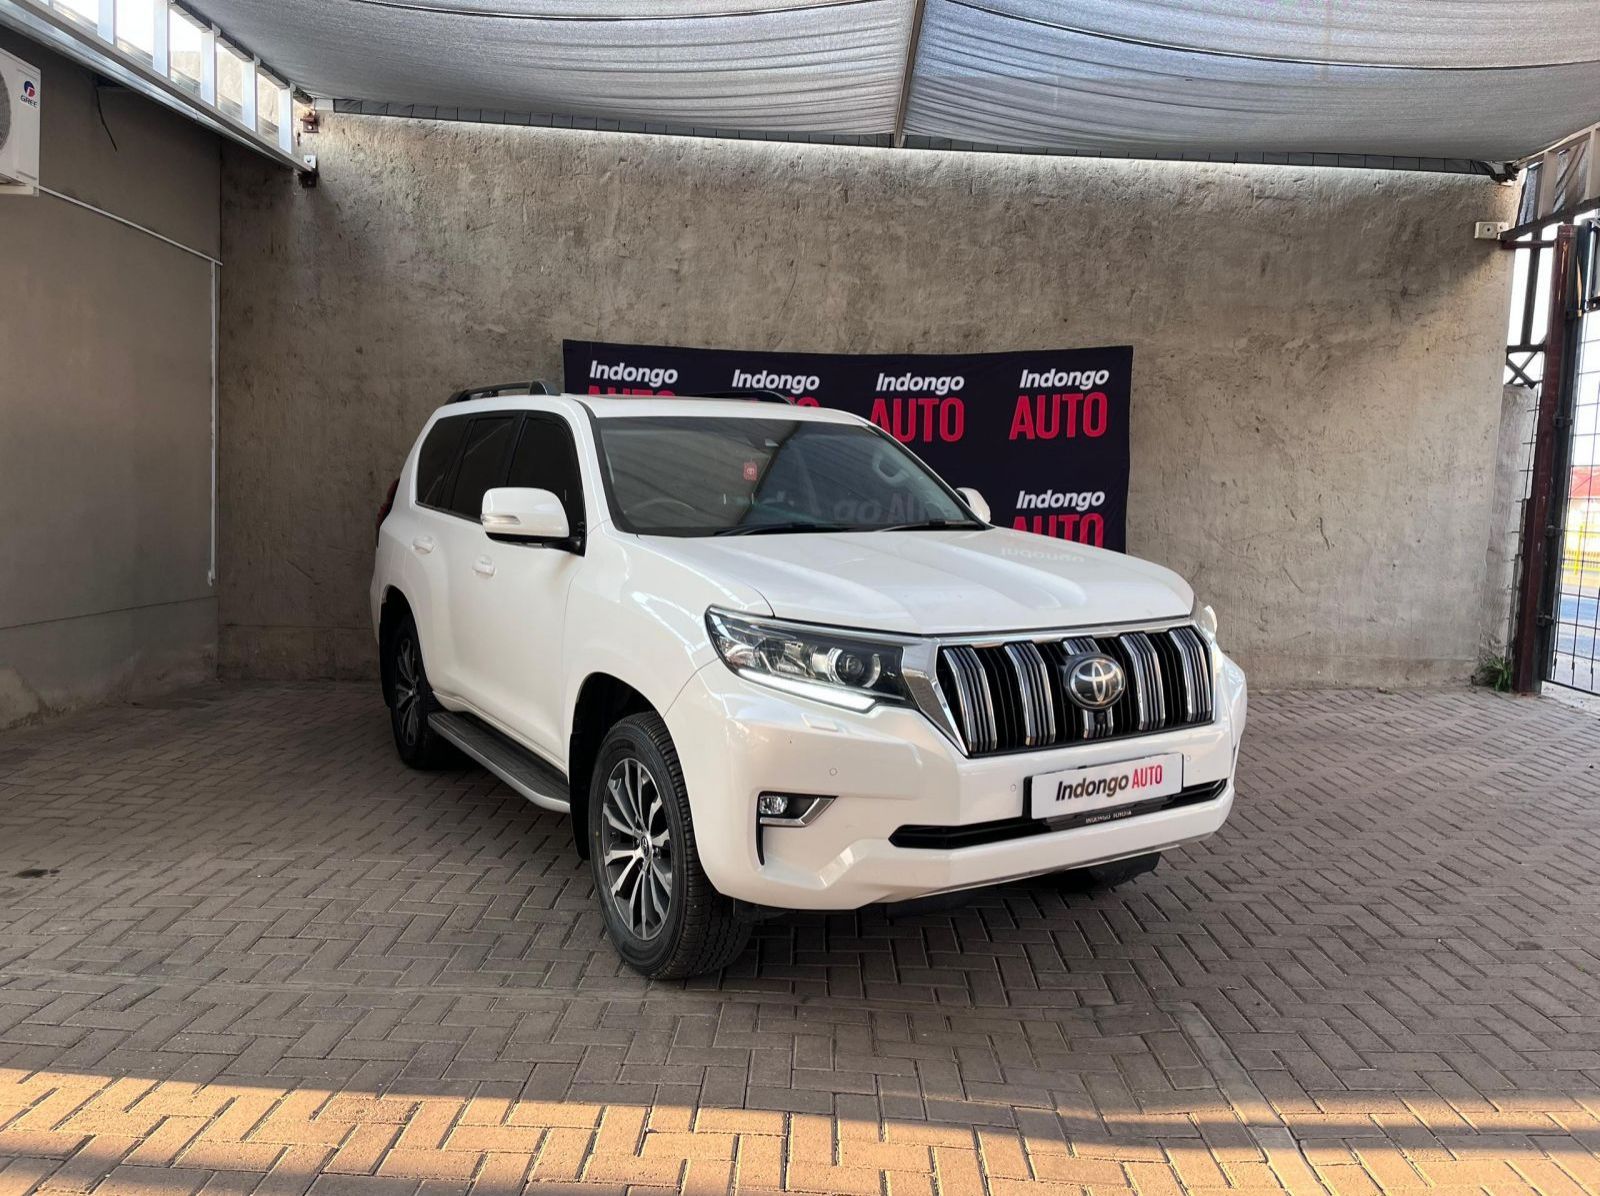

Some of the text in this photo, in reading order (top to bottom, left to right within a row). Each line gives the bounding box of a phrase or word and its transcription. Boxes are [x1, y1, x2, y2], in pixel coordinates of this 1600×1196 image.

[589, 360, 679, 388] Indongo
[732, 369, 820, 393] Indongo
[876, 373, 965, 396] Indongo
[1019, 369, 1109, 391] Indongo
[869, 397, 965, 443] AUTO
[1009, 392, 1108, 440] AUTO
[1015, 489, 1106, 512] Indongo
[1056, 765, 1163, 801] Indongo AUTO
